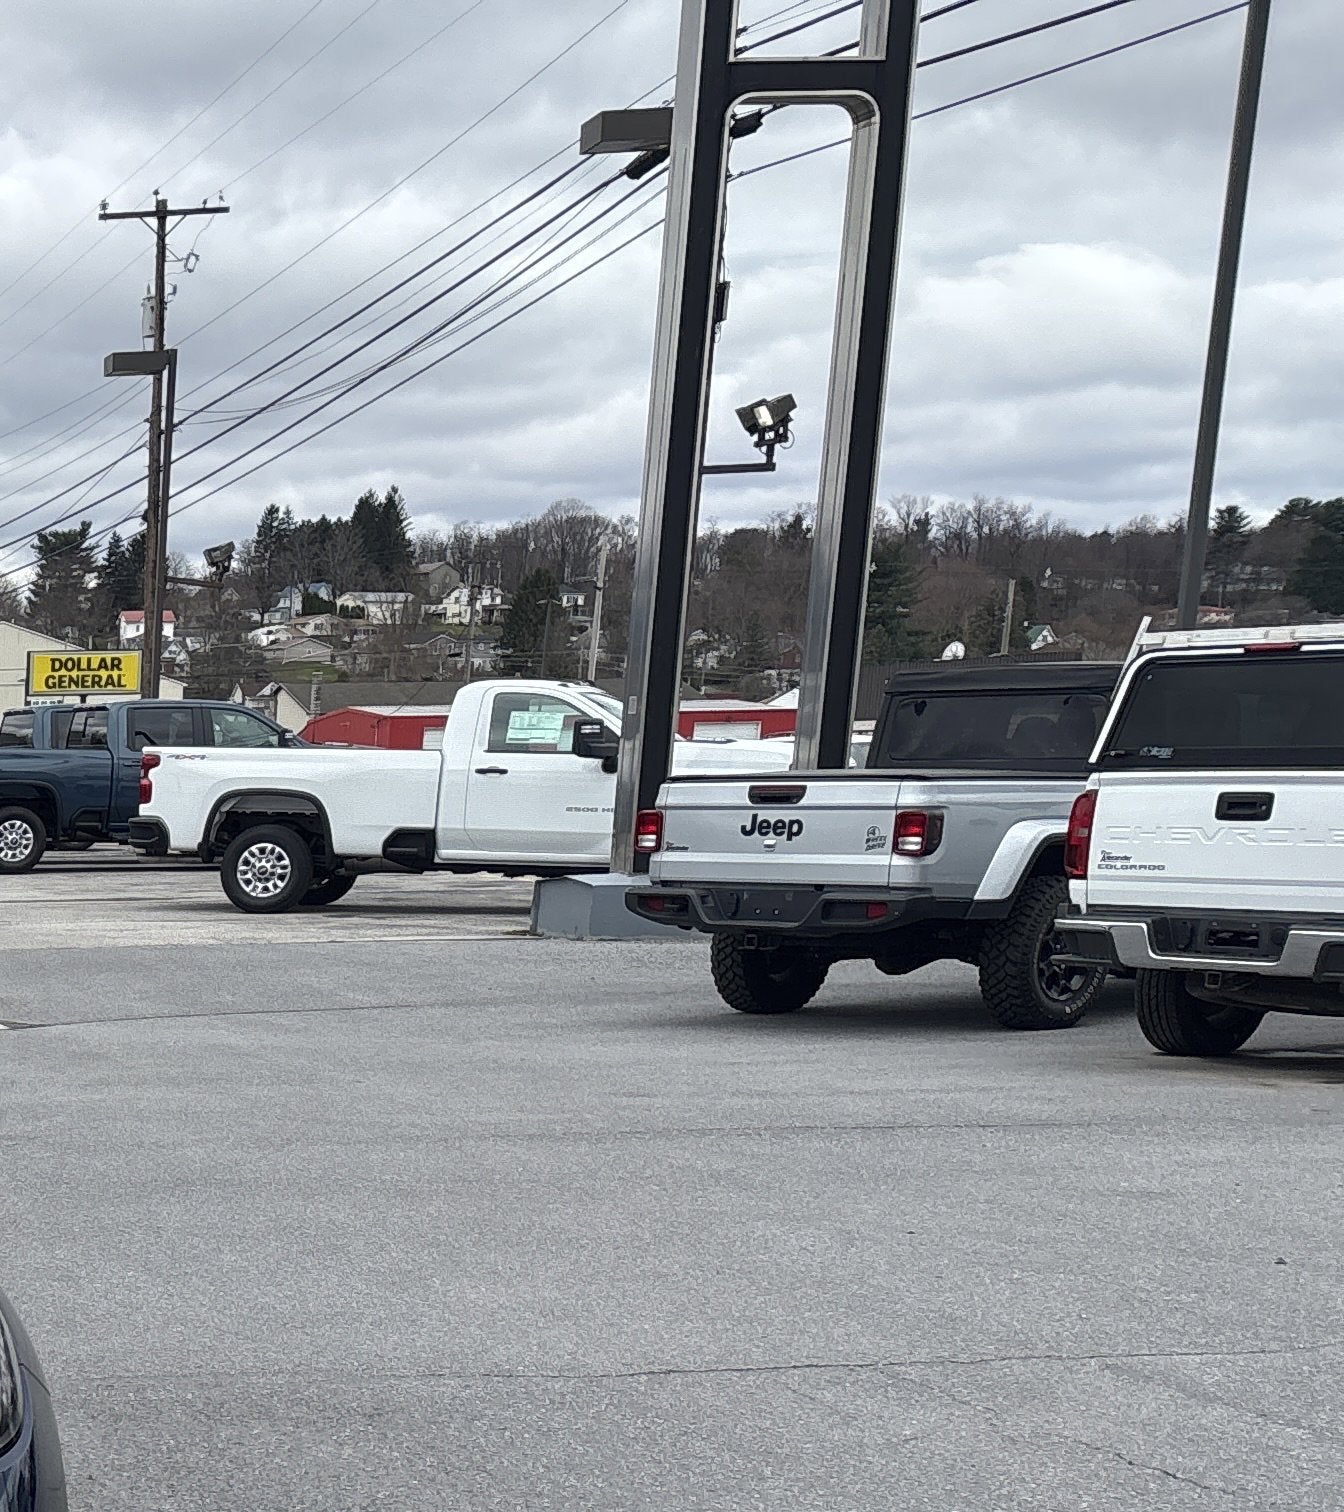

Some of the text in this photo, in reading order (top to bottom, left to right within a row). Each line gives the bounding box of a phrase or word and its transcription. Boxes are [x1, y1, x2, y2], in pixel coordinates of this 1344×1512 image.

[49, 656, 123, 672] DOLLAR
[44, 673, 127, 689] GENERAL
[741, 813, 803, 841] Jeep
[1097, 863, 1166, 871] COLORADO
